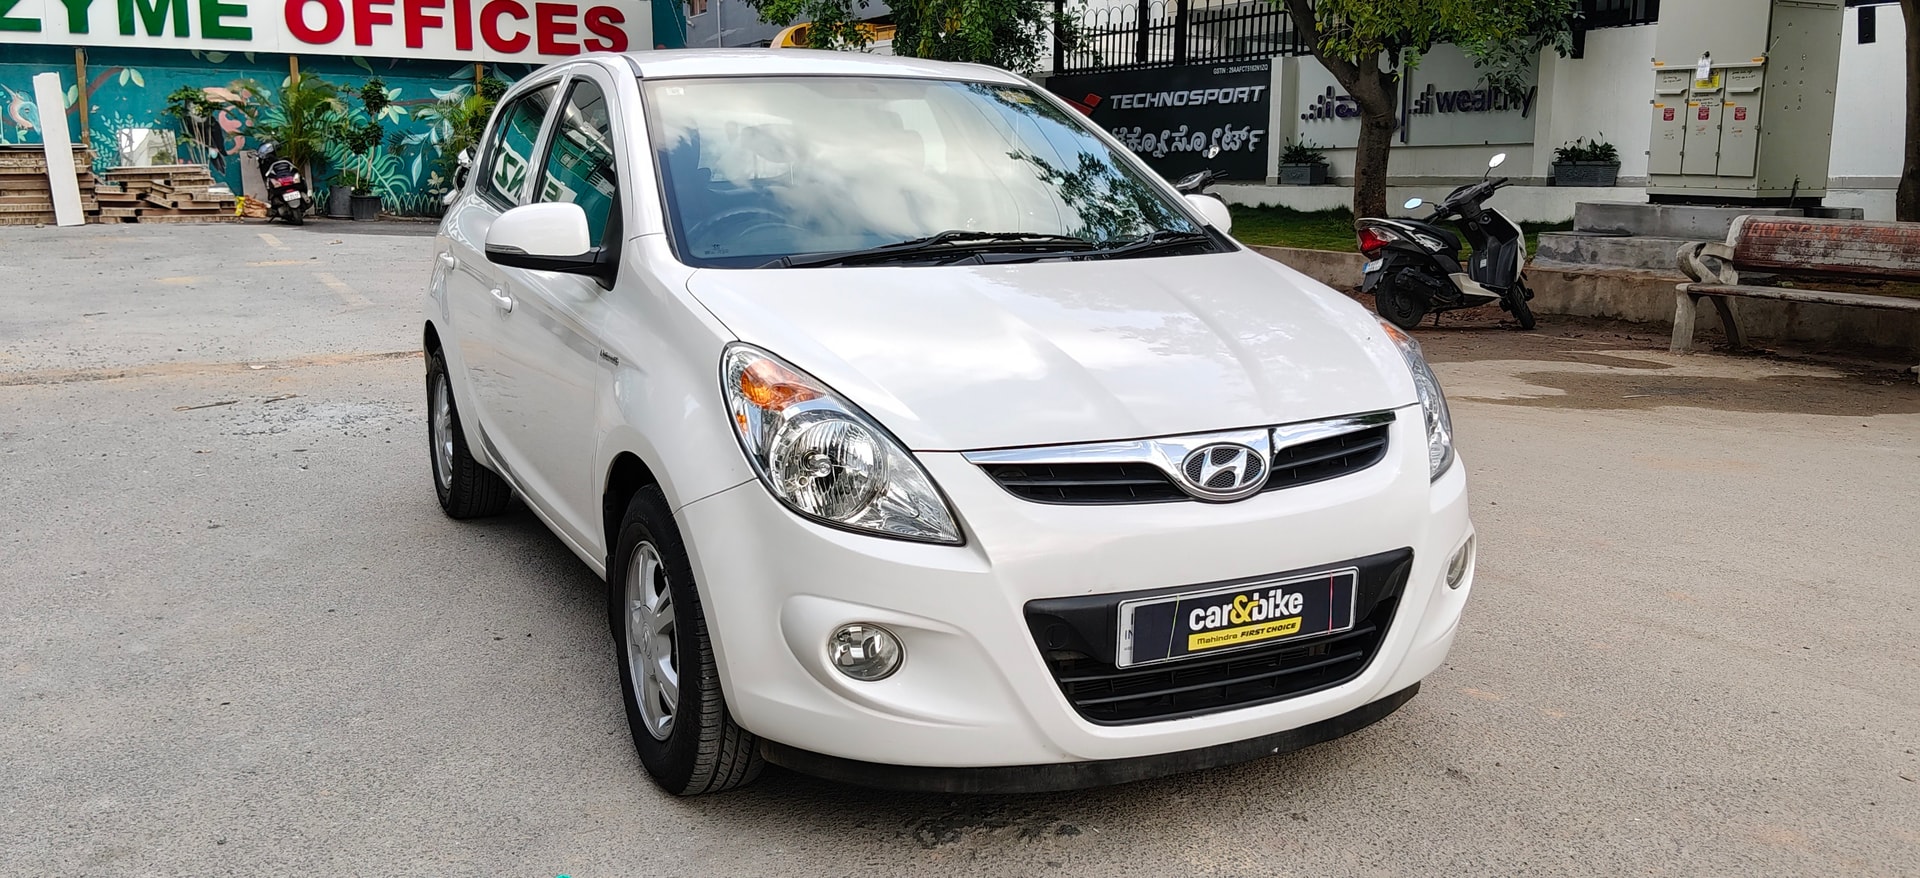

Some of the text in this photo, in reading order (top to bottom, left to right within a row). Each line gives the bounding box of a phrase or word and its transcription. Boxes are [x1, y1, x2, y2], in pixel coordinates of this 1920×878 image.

[284, 0, 629, 56] OFFICES
[1110, 85, 1266, 109] TECHNOSPORT
[1436, 85, 1537, 118] wealthy
[1189, 588, 1304, 631] car&bike
[1197, 622, 1297, 645] Mahindra FIRST CHOICE
